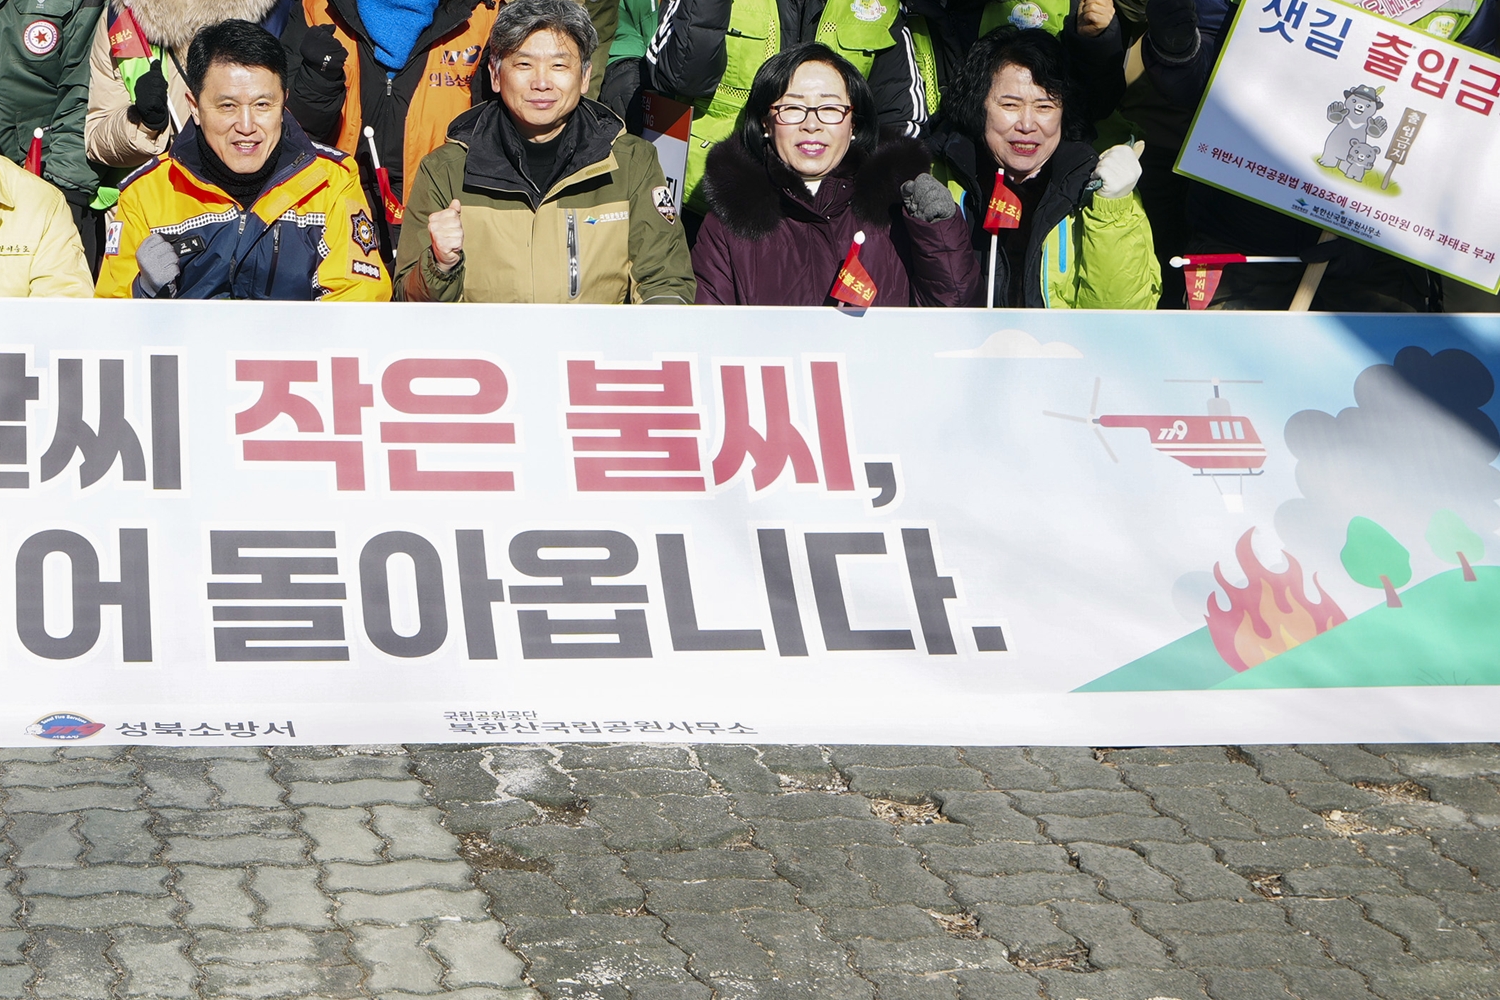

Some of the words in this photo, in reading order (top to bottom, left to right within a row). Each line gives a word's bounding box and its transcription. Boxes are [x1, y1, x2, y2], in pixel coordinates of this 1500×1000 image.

[1363, 30, 1500, 117] 출입금
[1390, 112, 1420, 162] 출입금지
[1210, 147, 1244, 169] 위반시
[1244, 162, 1300, 190] 자연공원법
[1301, 181, 1349, 208] 제28조에
[1349, 199, 1372, 217] 의거
[1373, 208, 1411, 232] 50만원
[1412, 223, 1434, 241] 이하
[1436, 231, 1470, 254] 과태료
[1472, 246, 1496, 265] 부과
[1312, 204, 1382, 238] 북한산국립공원사무소
[235, 356, 516, 492] 작은
[565, 358, 897, 509] 불씨,
[1157, 420, 1188, 440] 119
[207, 527, 1008, 664] 돌아옵니다.
[115, 720, 297, 738] 성북소방서
[443, 710, 538, 721] 국립공원공단
[448, 719, 758, 737] 북한산국립공원사무소
